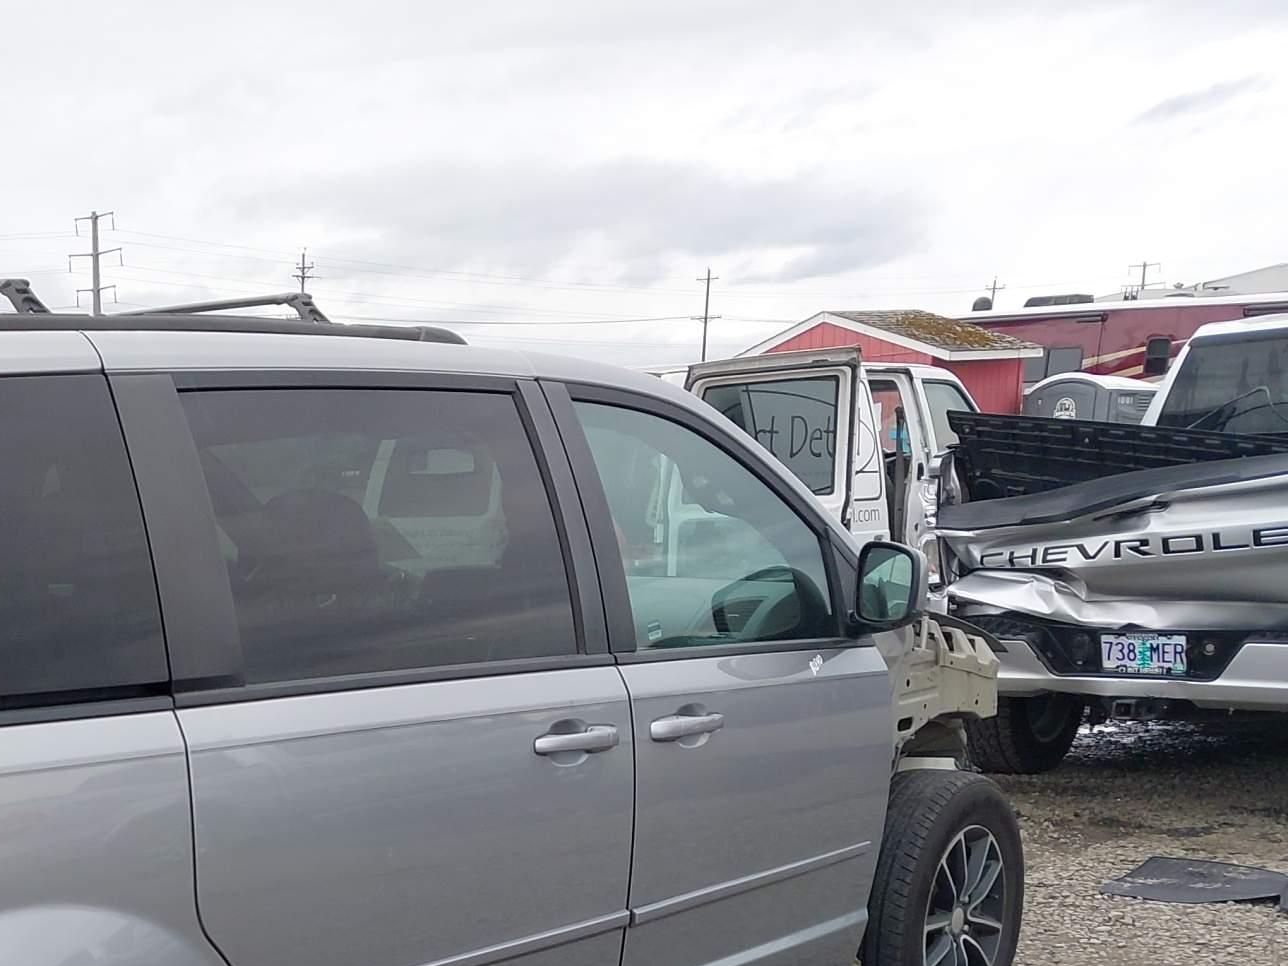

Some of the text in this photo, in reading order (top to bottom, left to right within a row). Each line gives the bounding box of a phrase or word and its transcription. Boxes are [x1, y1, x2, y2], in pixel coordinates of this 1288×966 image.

[853, 508, 880, 523] l.com
[1103, 641, 1184, 667] 738 MER
